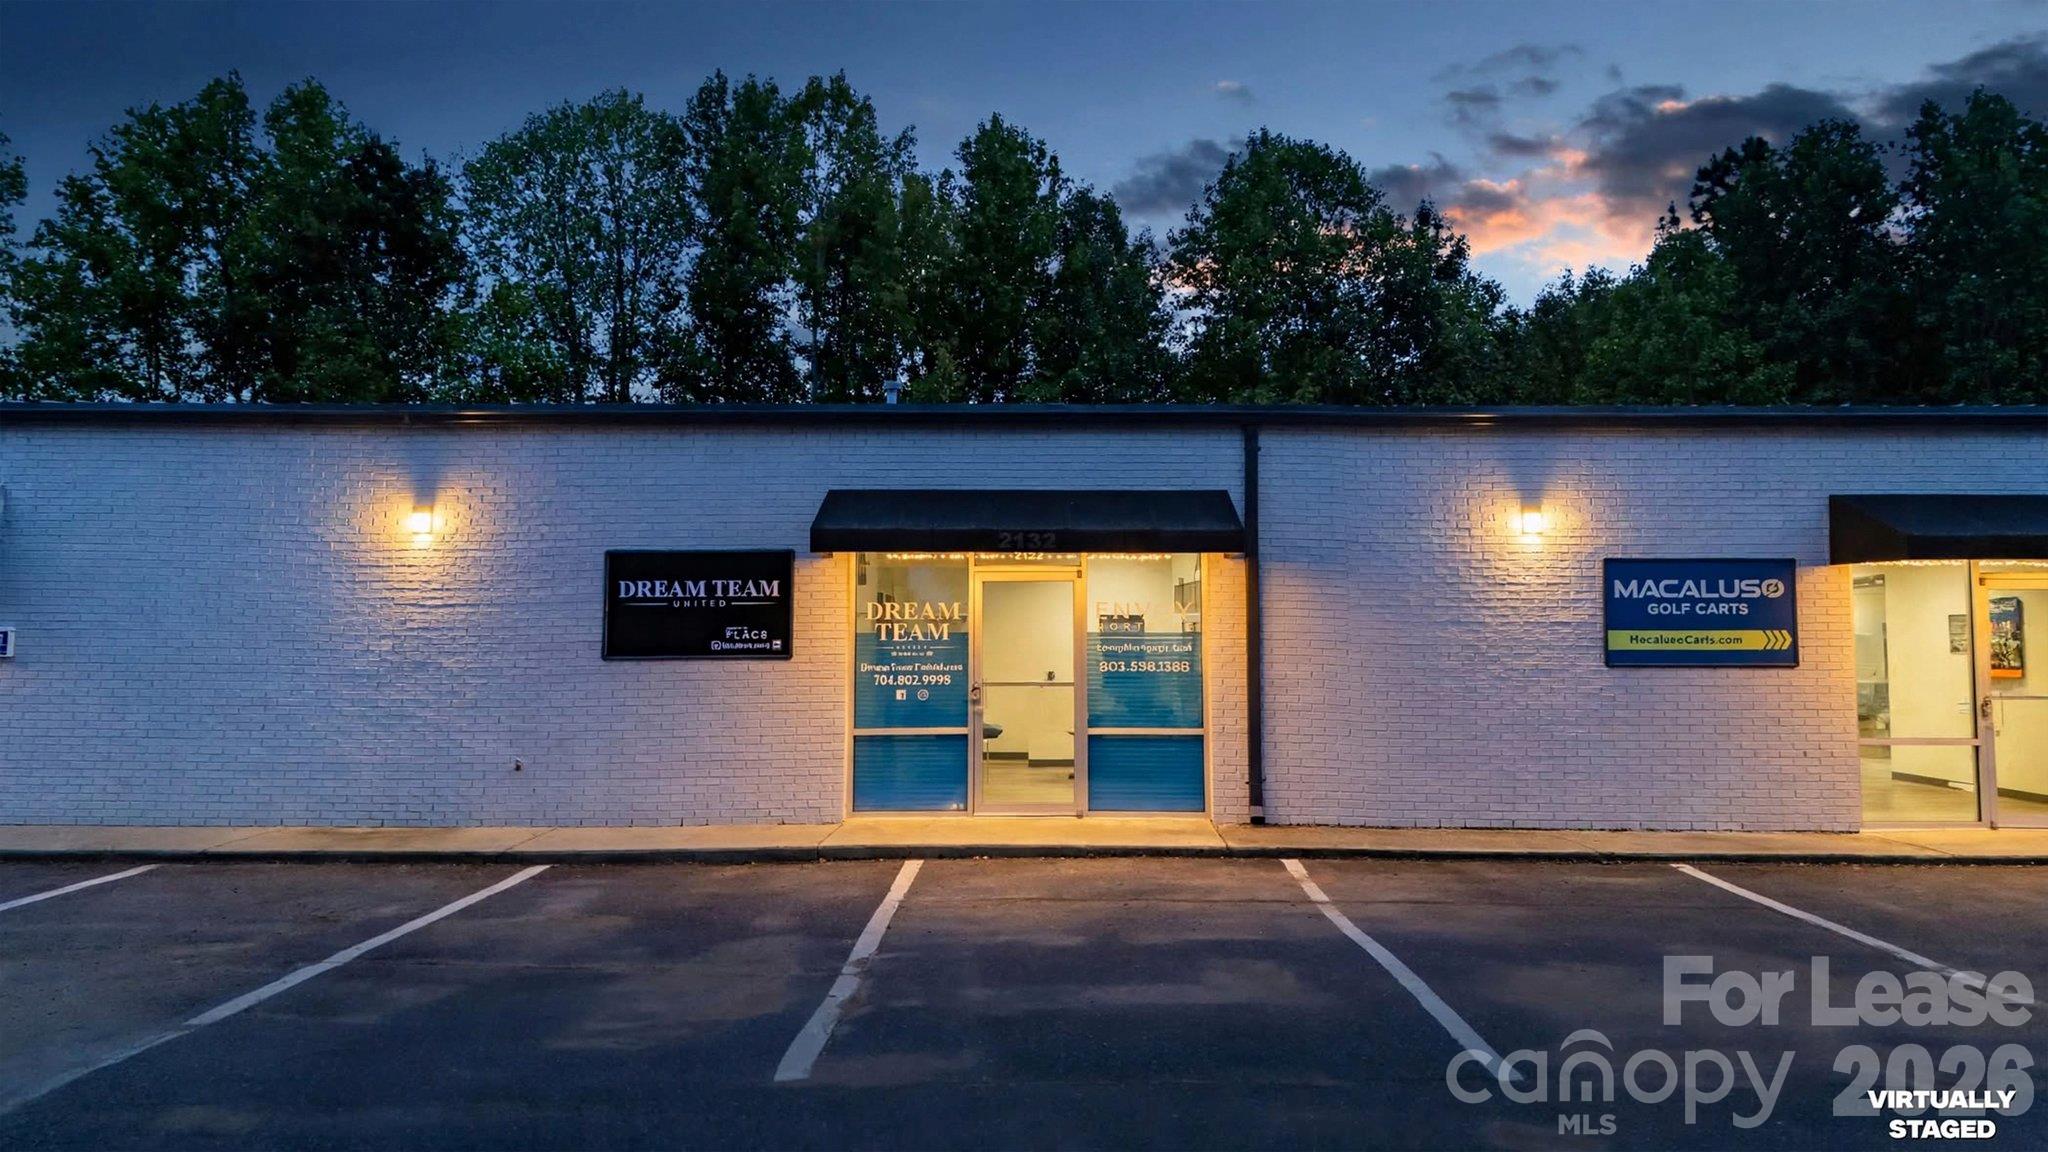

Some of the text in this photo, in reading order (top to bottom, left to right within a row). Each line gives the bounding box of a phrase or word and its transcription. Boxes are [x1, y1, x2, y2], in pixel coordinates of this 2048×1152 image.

[1000, 532, 1056, 549] 2132
[618, 580, 781, 598] DREAM TEAM
[1613, 579, 1785, 598] MACALUSO
[673, 600, 727, 608] UNITED
[865, 602, 961, 620] DREAM
[1647, 603, 1749, 615] GOLF CARTS
[875, 623, 950, 642] TEAM
